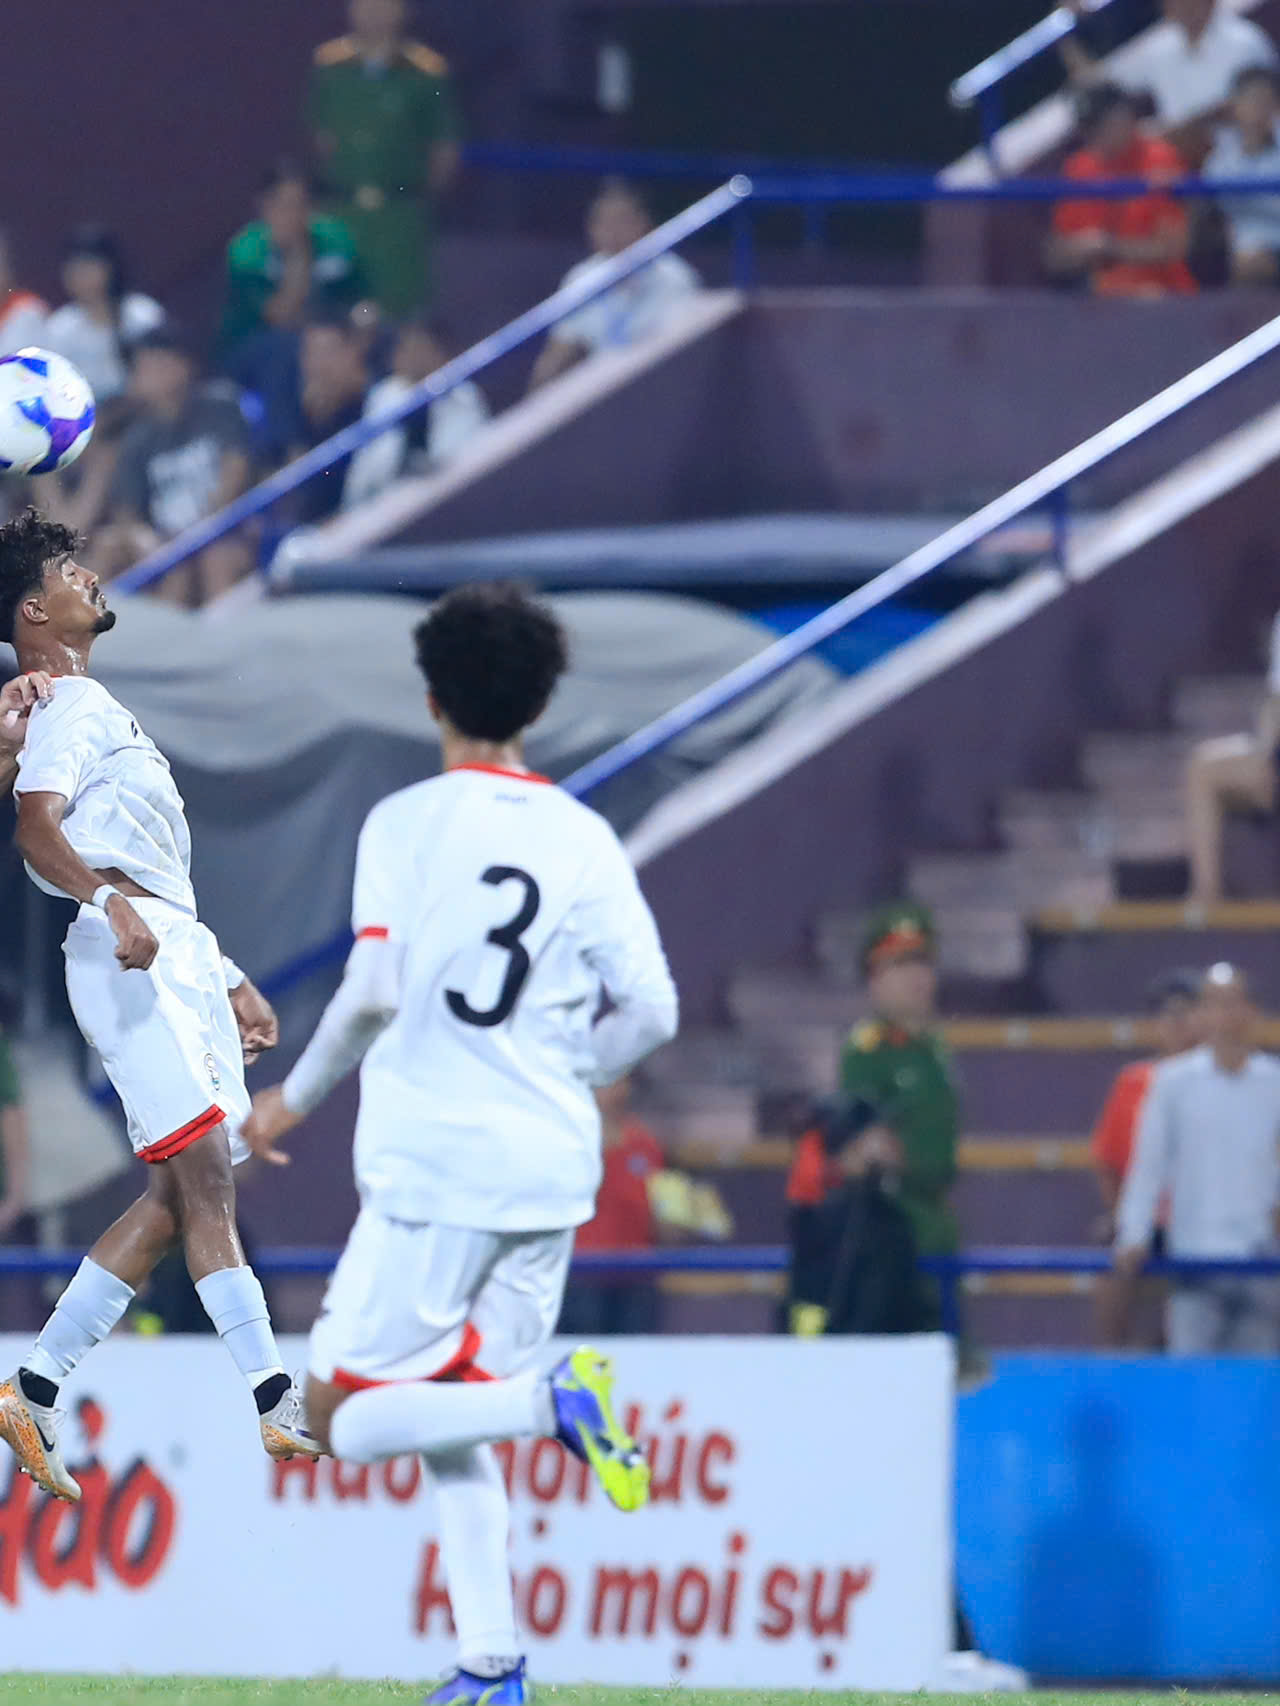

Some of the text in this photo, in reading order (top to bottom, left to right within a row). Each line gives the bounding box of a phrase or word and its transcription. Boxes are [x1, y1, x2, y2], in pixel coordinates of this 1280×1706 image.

[444, 865, 541, 1027] 3
[412, 1530, 873, 1672] Ho mọi sự
